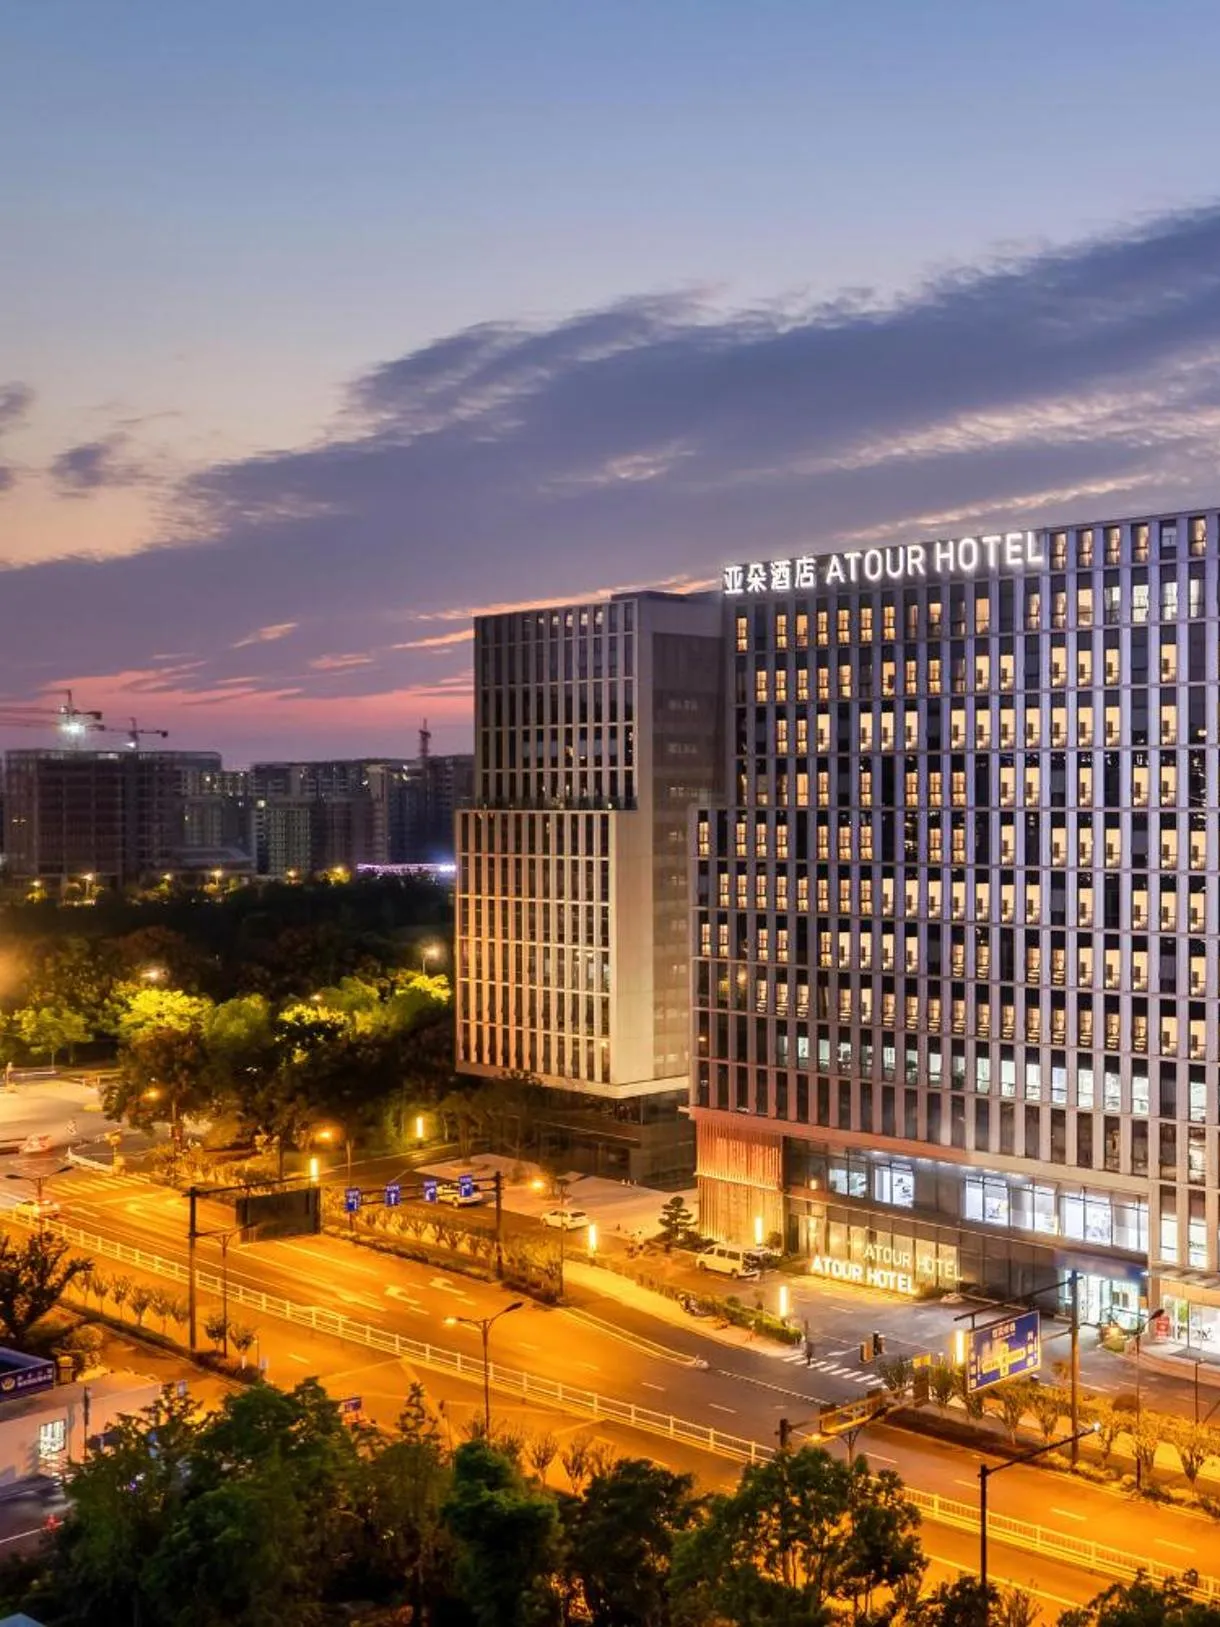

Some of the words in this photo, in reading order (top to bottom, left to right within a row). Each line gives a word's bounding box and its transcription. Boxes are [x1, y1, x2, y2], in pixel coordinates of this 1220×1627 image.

[723, 556, 816, 594] 亚朵酒店
[826, 544, 925, 584] ATOUR
[935, 531, 1045, 573] HOTEL
[812, 1255, 863, 1281] ATOUR
[866, 1267, 916, 1294] HOTEL
[864, 1245, 912, 1269] ATOUR
[916, 1256, 964, 1281] HOTEL
